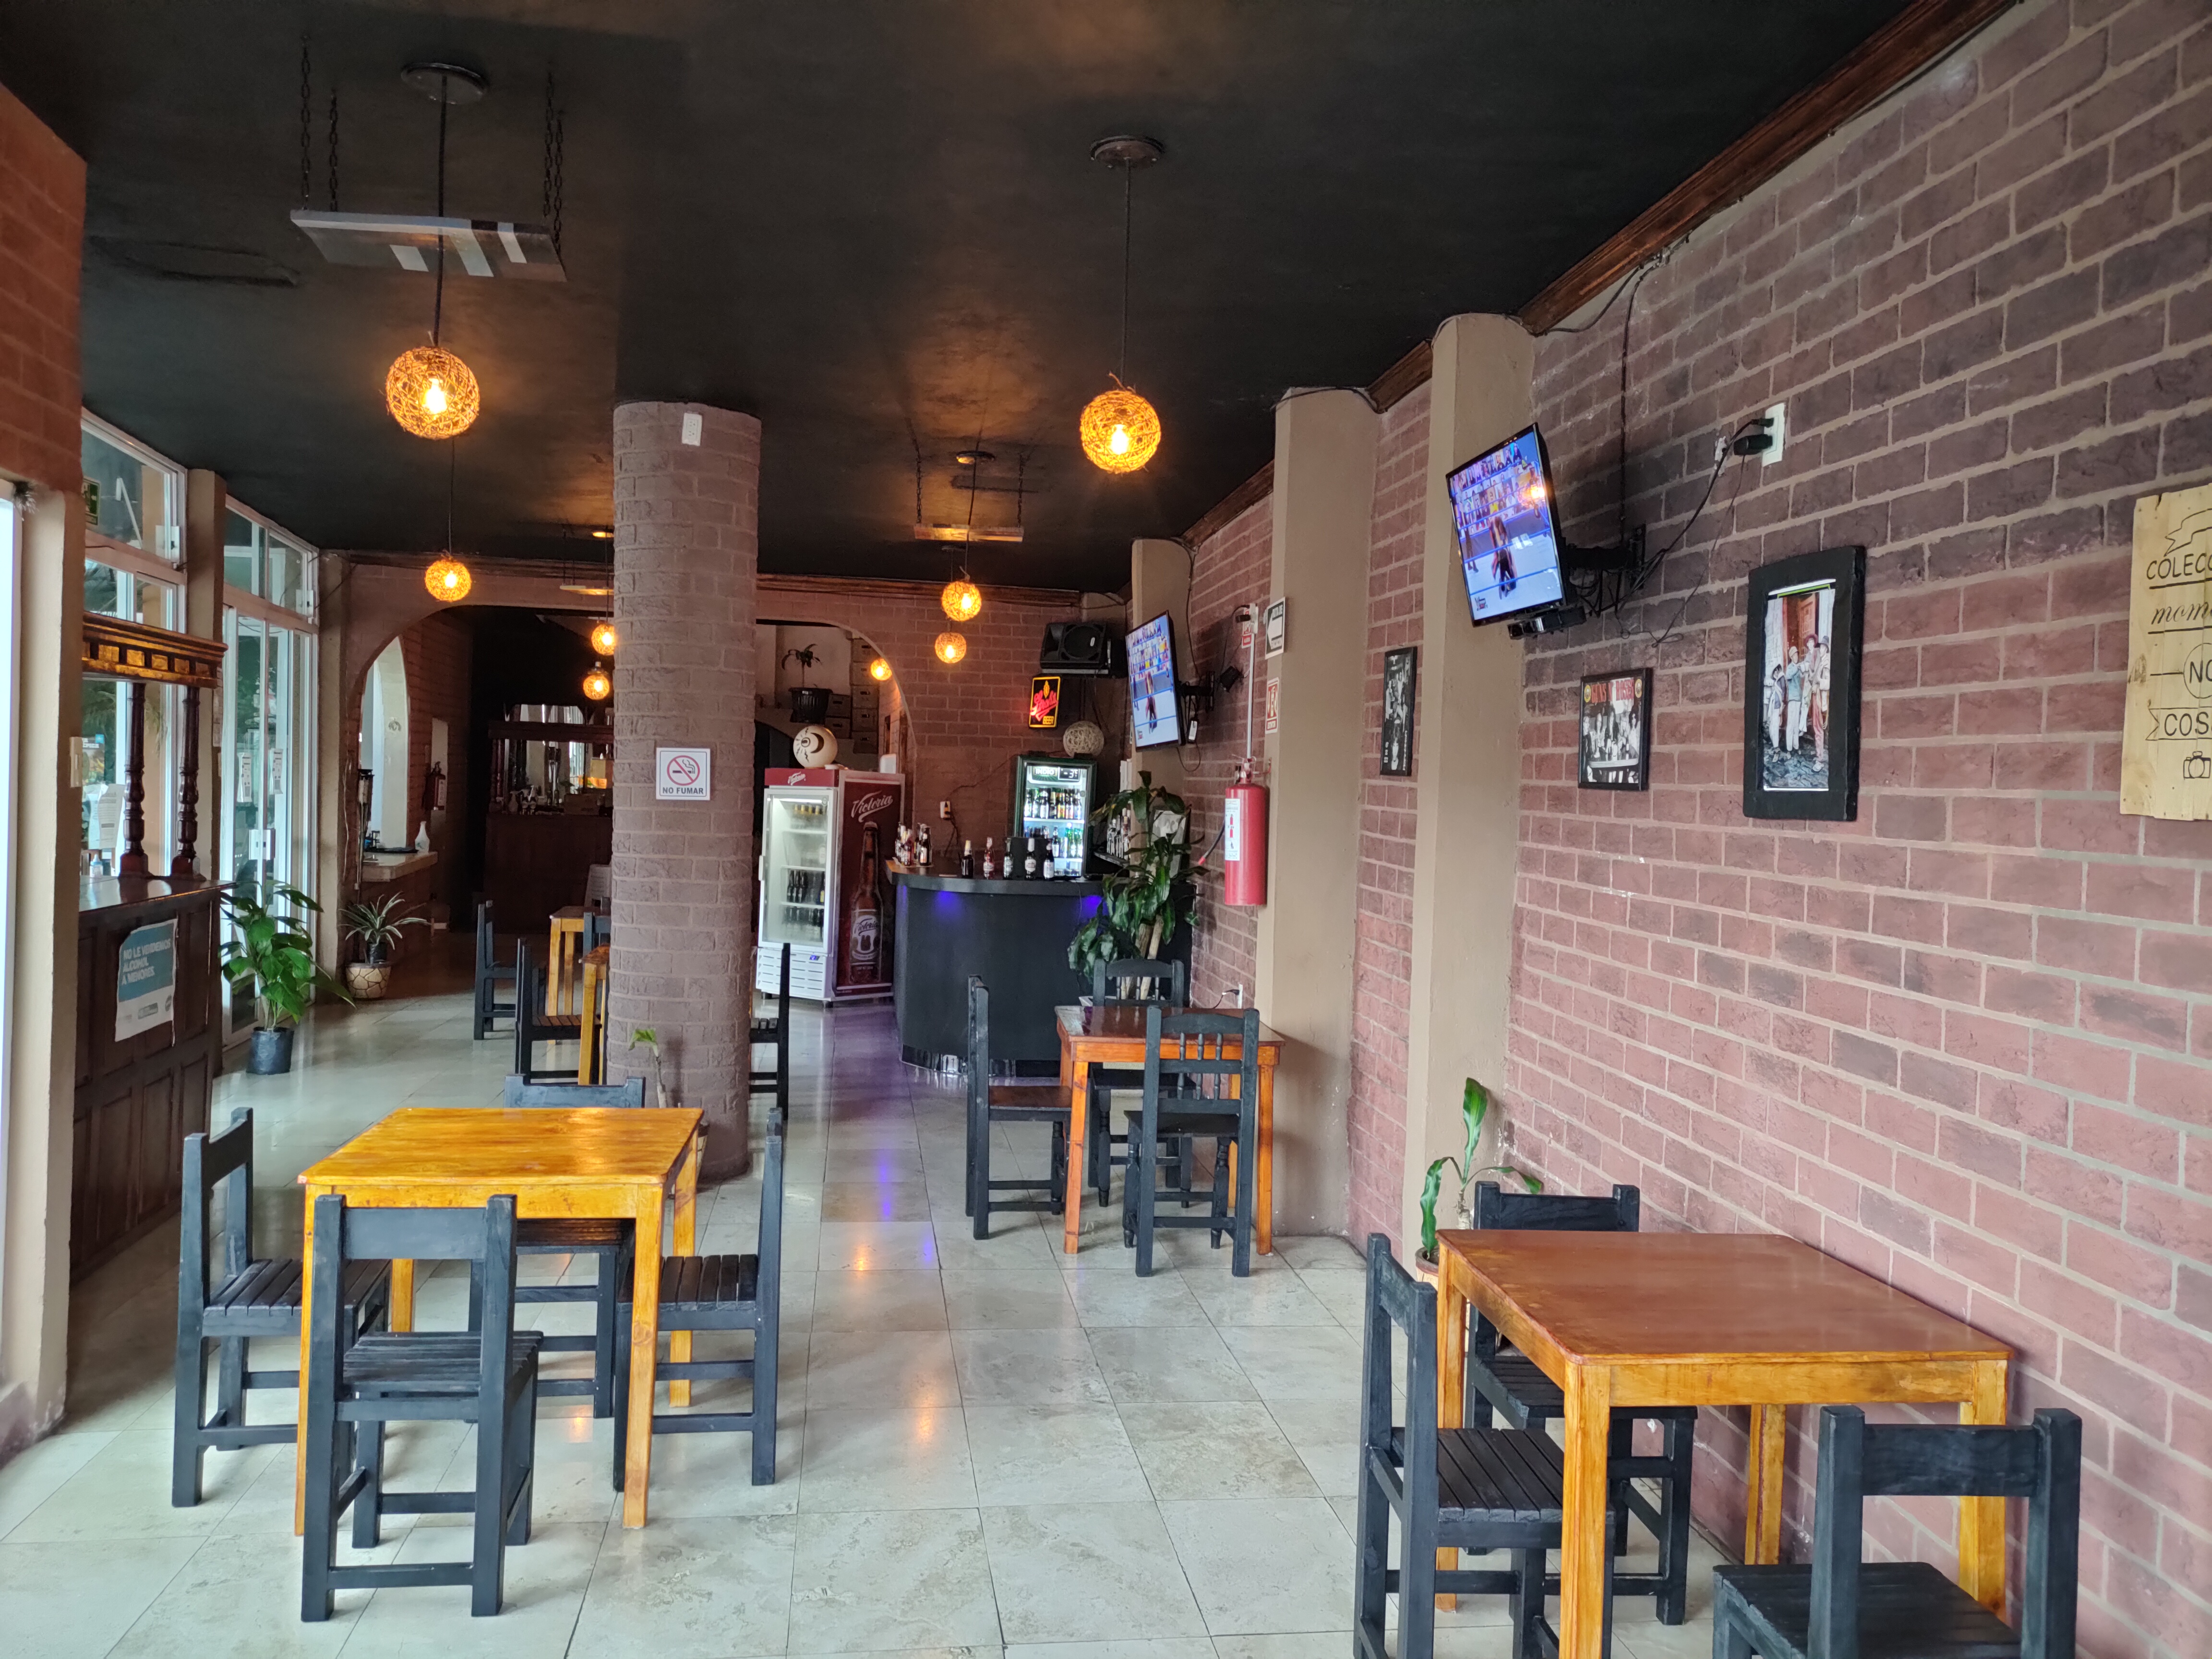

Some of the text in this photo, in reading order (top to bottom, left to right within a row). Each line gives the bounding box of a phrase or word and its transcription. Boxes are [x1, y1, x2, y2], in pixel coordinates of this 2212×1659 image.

[1591, 683, 1607, 703] GUNS
[1616, 679, 1634, 701] ROSES
[2164, 711, 2212, 736] COS
[788, 771, 806, 785] Victoria
[851, 790, 893, 822] Victoria
[854, 917, 879, 936] Victoria
[123, 938, 171, 961] NO LE VENDEMOS
[121, 965, 155, 985] A MENORES
[123, 956, 149, 973] ALCOHOL
